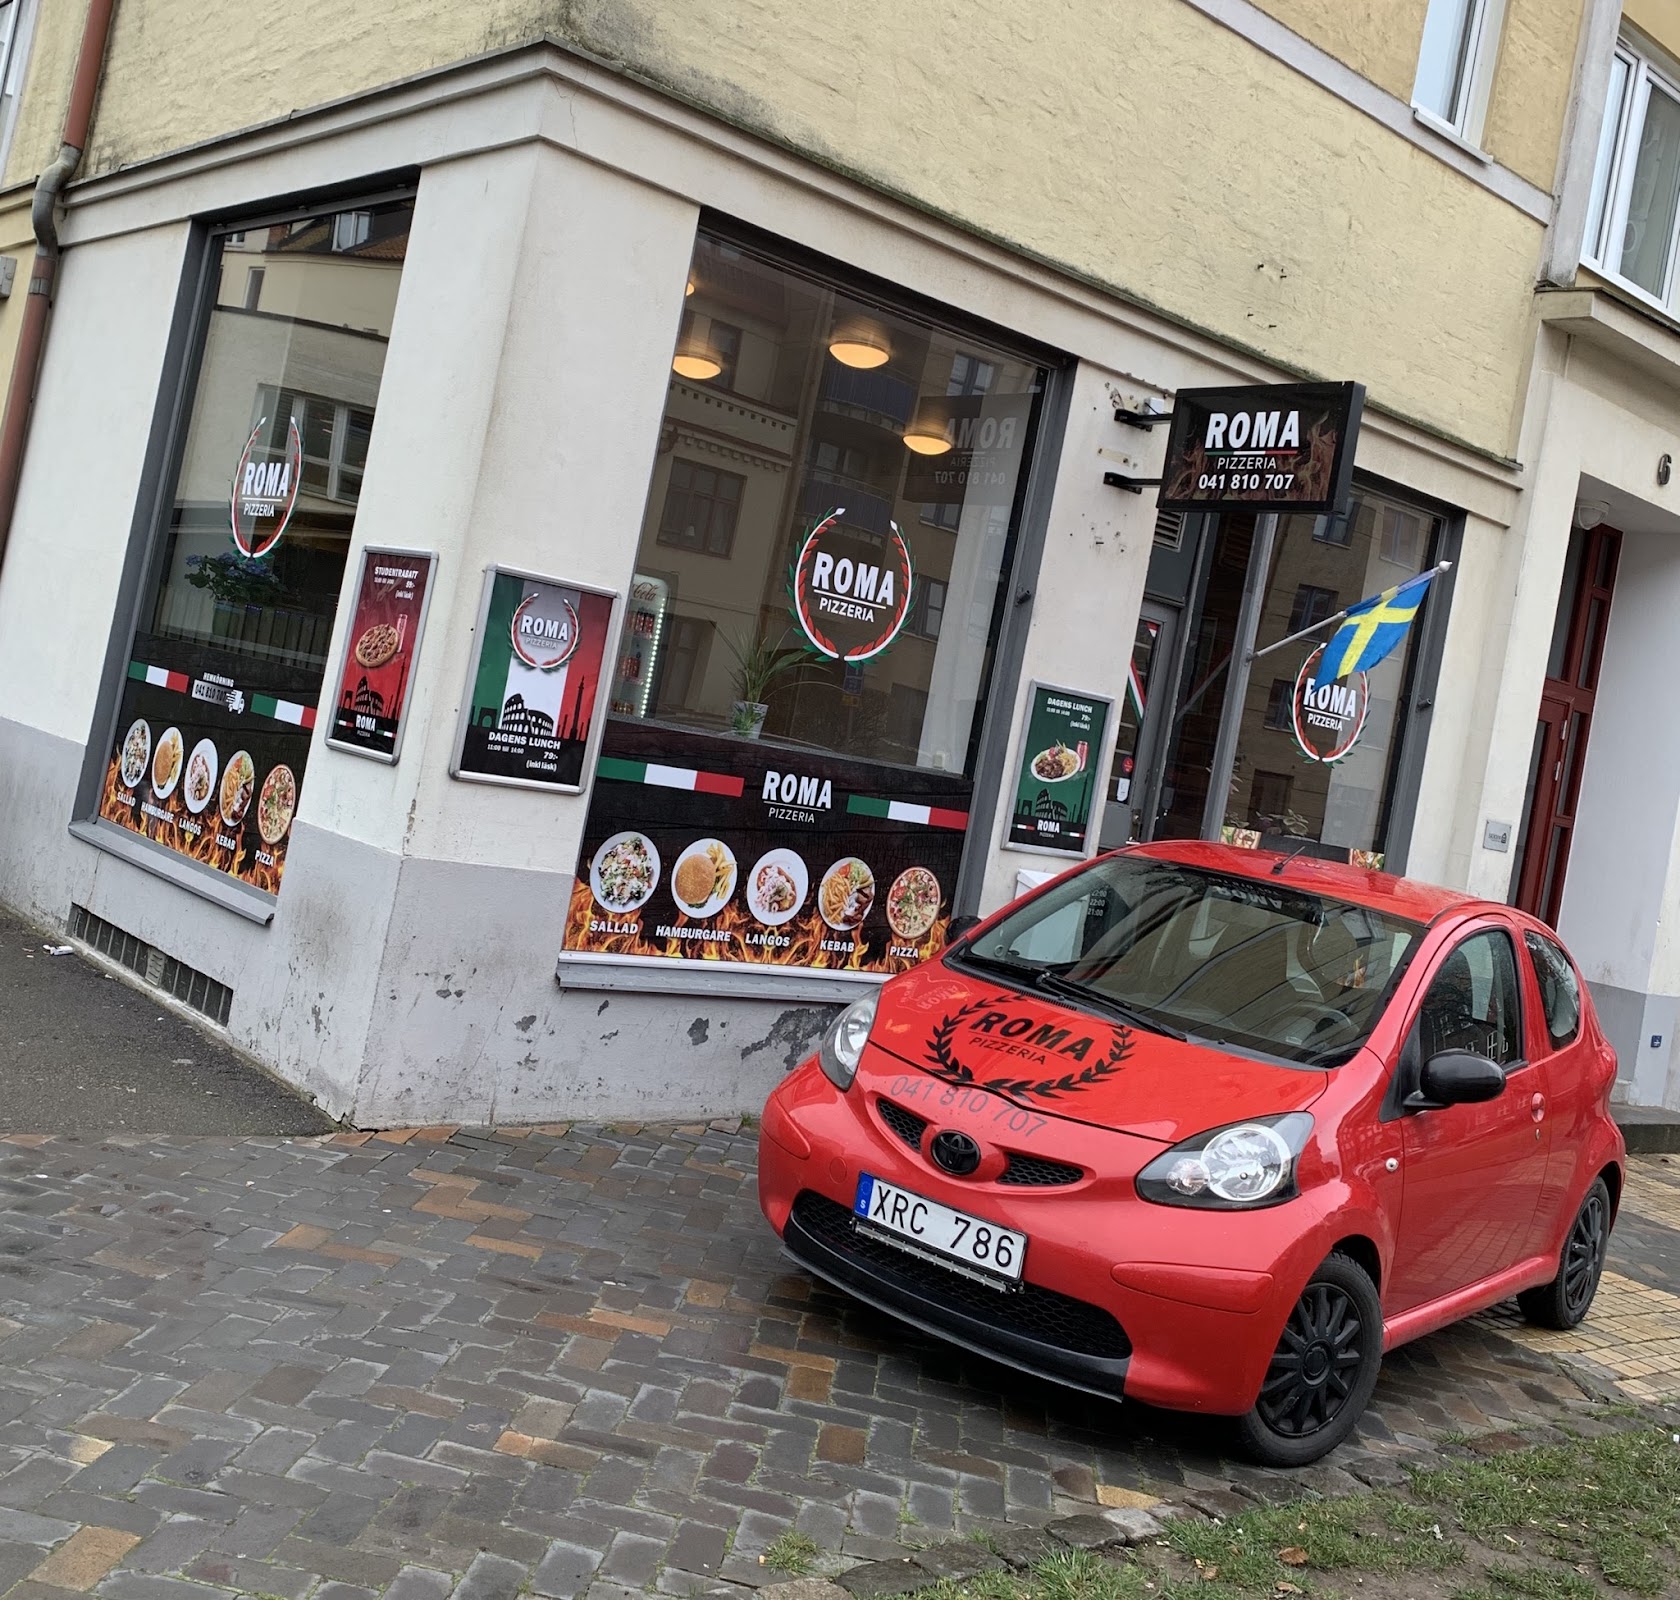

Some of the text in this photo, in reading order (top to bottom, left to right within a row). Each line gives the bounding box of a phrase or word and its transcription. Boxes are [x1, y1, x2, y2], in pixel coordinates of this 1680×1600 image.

[1205, 411, 1299, 448] ROMA
[1217, 457, 1277, 469] PIZZERIA
[1656, 453, 1672, 486] 6
[241, 462, 290, 497] ROMA
[1199, 474, 1294, 489] 041 810 707
[243, 503, 275, 517] PIZZERIA
[374, 566, 419, 579] STUDENTRABATT
[811, 551, 894, 607] ROMA
[819, 597, 875, 623] PIZZERIA
[521, 614, 568, 641] ROMA
[525, 638, 558, 650] PIZZERIA
[1047, 697, 1072, 708] DAGENS
[1072, 703, 1093, 713] LUNCH
[1303, 677, 1357, 718] ROMA
[356, 714, 376, 731] ROMA
[1307, 713, 1343, 732] PIZZERIA
[488, 731, 561, 750] DAGENS LUNCH
[762, 770, 832, 809] ROMA
[117, 792, 136, 807] SALLAD
[141, 801, 175, 824] HAMBURGARE
[768, 807, 815, 823] PIZZERIA
[178, 817, 202, 836] LANGOS
[1037, 819, 1060, 833] ROMA
[215, 833, 237, 851] KEBAB
[254, 849, 275, 867] PIZZA
[589, 920, 639, 935] SALLAD
[655, 925, 732, 942] HAMBURGARE
[745, 933, 790, 947] LANGOS
[820, 939, 855, 953] KEBAB
[889, 946, 919, 959] PIZZA
[969, 1010, 1095, 1062] ROMA
[968, 1036, 1047, 1065] PIZZERIA
[890, 1076, 1048, 1137] 041 810 707
[859, 1198, 867, 1209] S
[873, 1184, 1015, 1268] XRC 786
